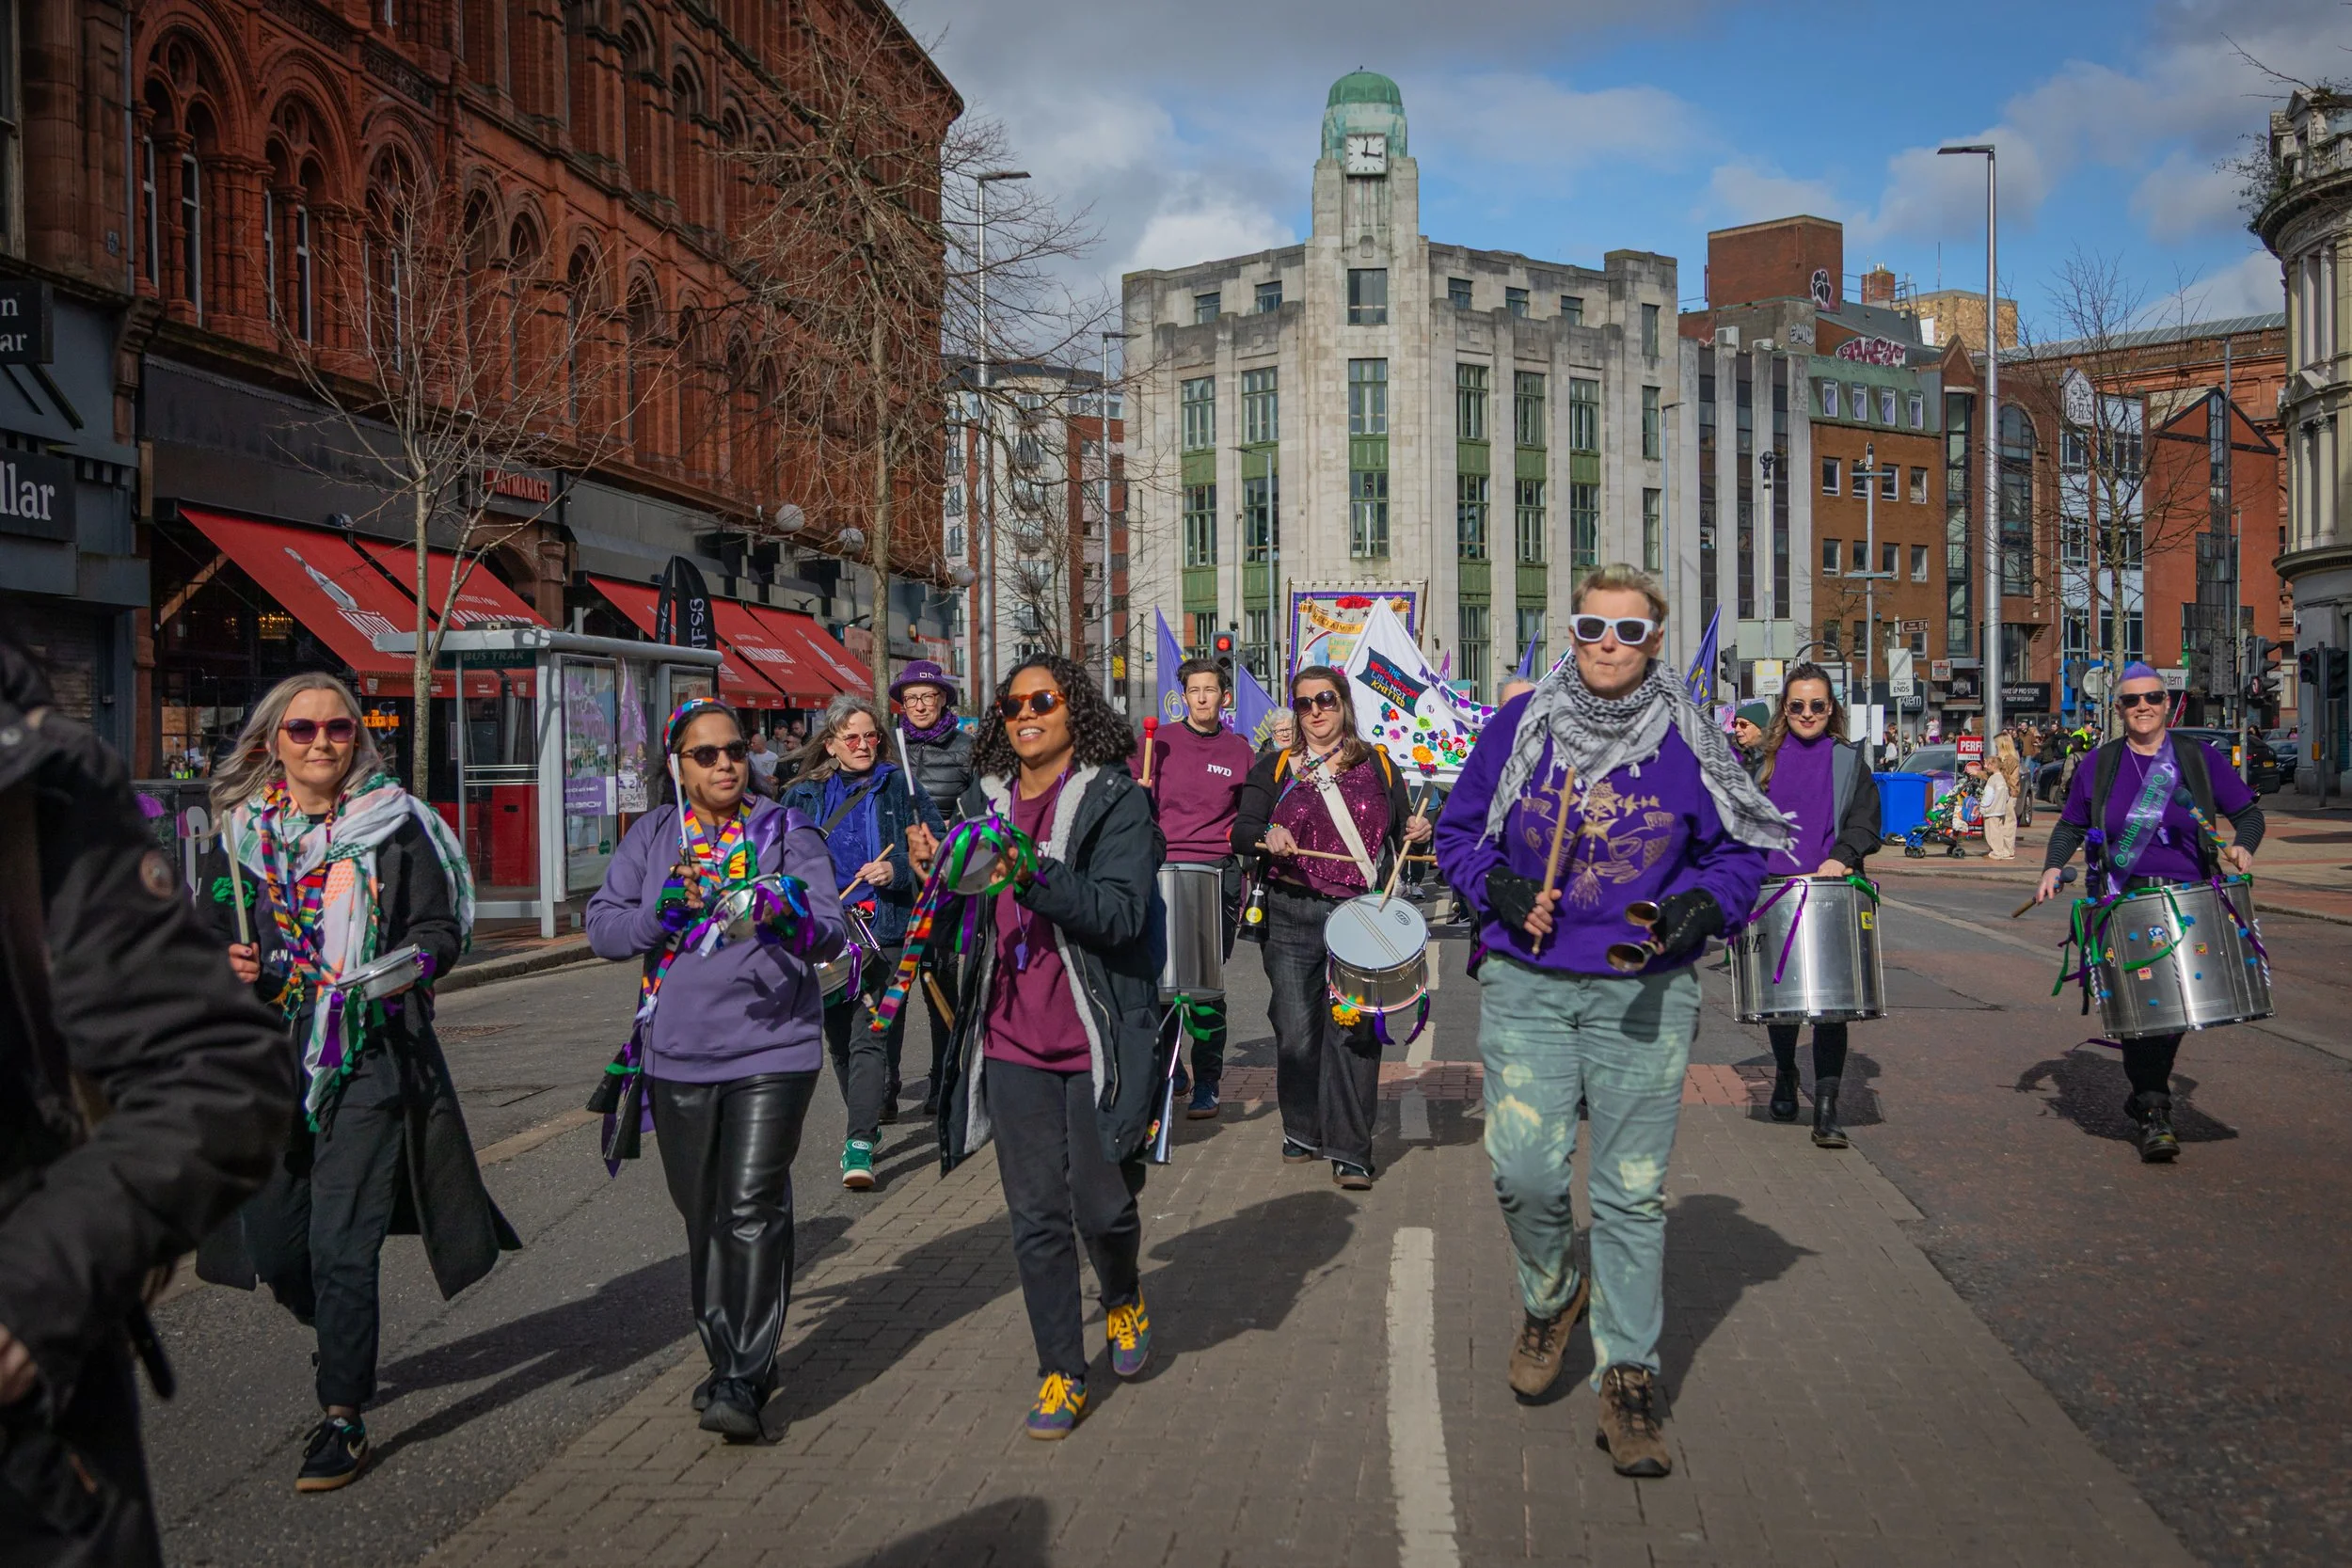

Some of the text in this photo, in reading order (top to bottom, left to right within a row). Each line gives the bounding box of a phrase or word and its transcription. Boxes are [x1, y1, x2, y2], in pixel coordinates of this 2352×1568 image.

[463, 651, 525, 661] BUS TRAK
[1370, 660, 1420, 700] REVOLUTION
[1389, 665, 1402, 681] THE
[1371, 670, 1390, 688] WILL
[1390, 684, 1407, 700] NOT
[1371, 679, 1406, 707] KNITTED
[1207, 763, 1232, 777] IWD
[1737, 933, 1767, 956] OPE
